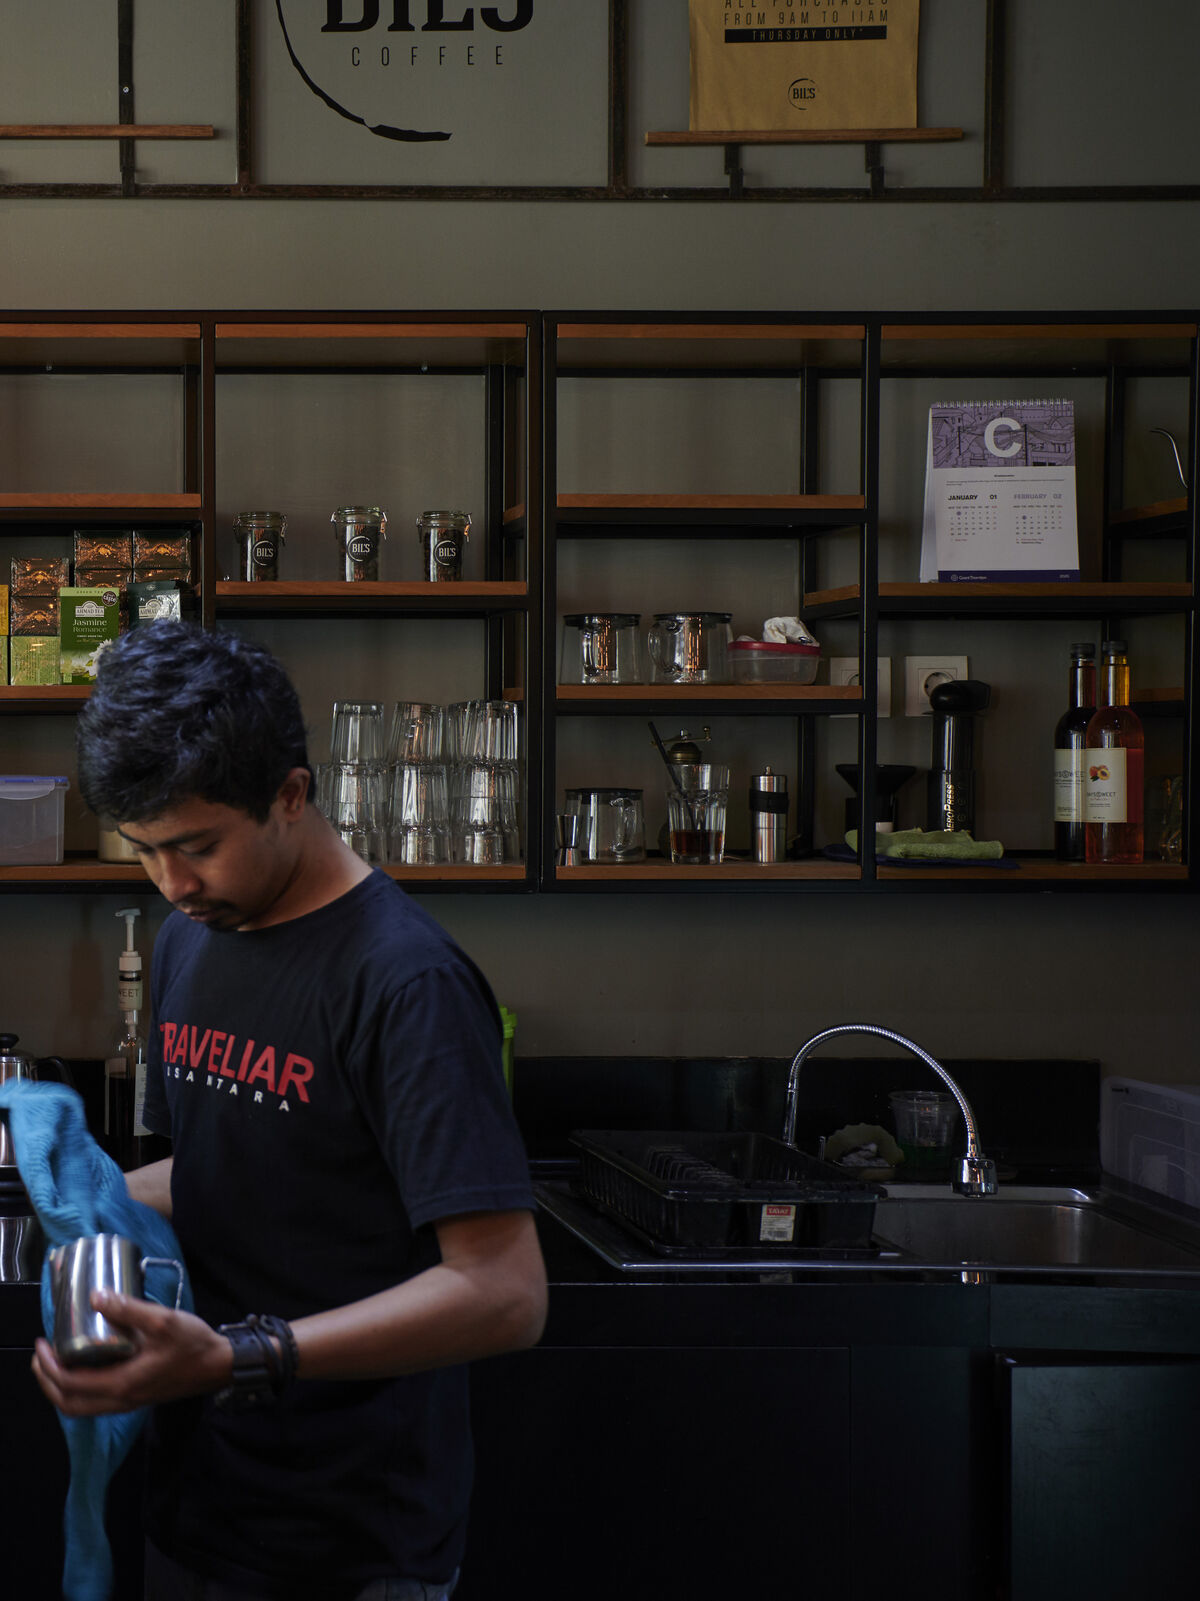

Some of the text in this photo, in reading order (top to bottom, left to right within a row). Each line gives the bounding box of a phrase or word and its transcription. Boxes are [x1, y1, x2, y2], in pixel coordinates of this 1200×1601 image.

[724, 12, 766, 26] FROM
[778, 11, 809, 24] 9AM
[822, 10, 839, 24] TO
[752, 28, 817, 41] THURSDAY
[351, 46, 503, 66] COFFEE
[792, 88, 816, 99] BIL'S
[984, 417, 1022, 458] C
[352, 543, 370, 553] BIL'S
[160, 1022, 315, 1103] RAVELIAR
